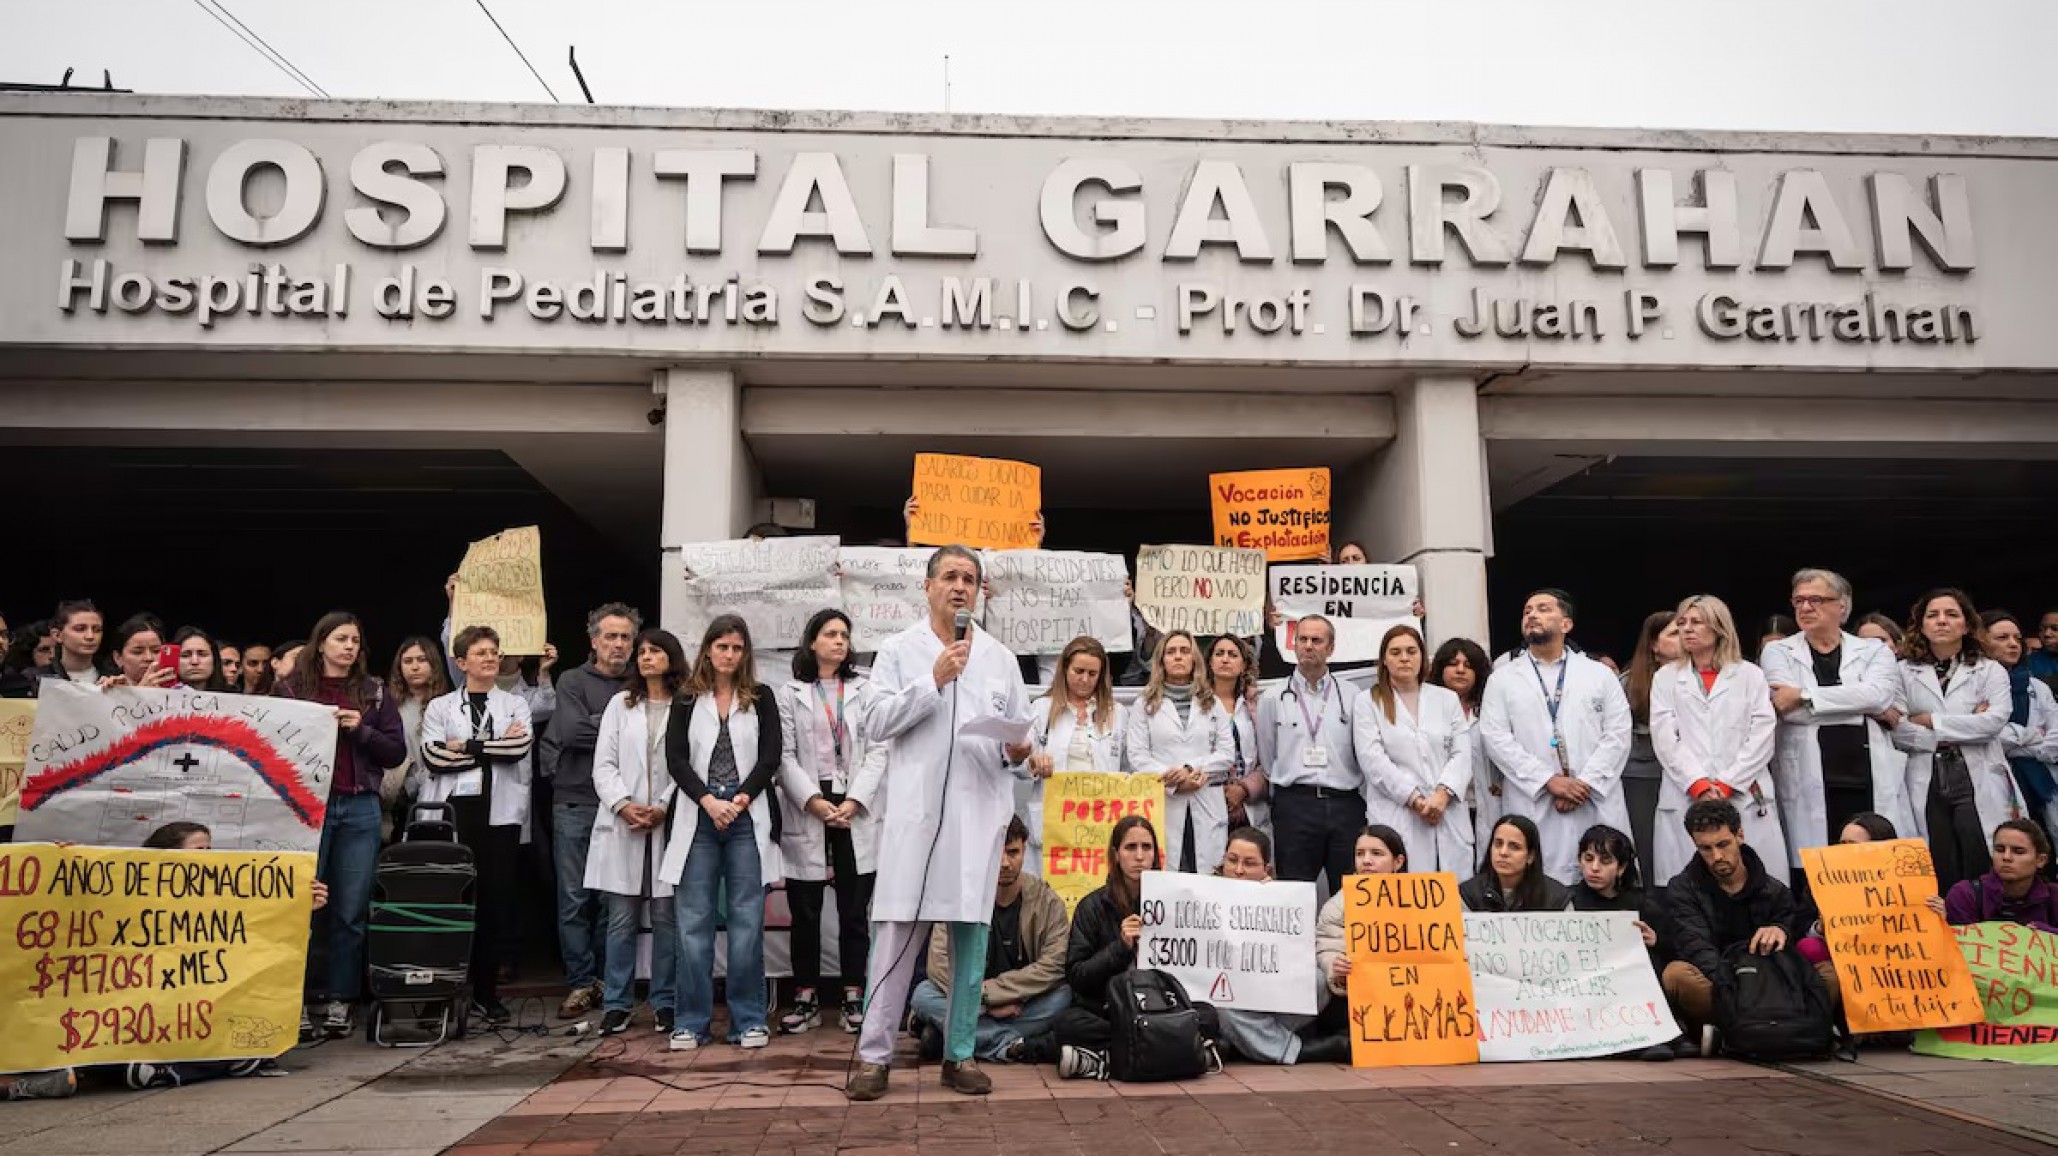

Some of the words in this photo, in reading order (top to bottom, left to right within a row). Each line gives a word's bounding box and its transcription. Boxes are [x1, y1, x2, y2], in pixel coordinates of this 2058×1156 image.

[65, 137, 977, 258] HOSPITAL
[1039, 156, 1977, 273] GARRAHAN
[58, 258, 349, 327] Hospital
[373, 265, 456, 320] de
[480, 266, 779, 324] Pediatria
[801, 272, 1117, 332] S.A.M.I.C.
[1178, 281, 1325, 336] Prof.
[1349, 282, 1432, 337] Dr.
[1453, 285, 1604, 340] Juan
[1626, 288, 1673, 341] P.
[1697, 291, 1981, 344] Garrahan
[920, 482, 952, 502] PARA
[960, 485, 1001, 506] CUIDAR
[1009, 490, 1024, 509] LA
[955, 516, 972, 539] DE
[993, 556, 1023, 581] SIN
[1034, 556, 1119, 584] RESIDENTES
[1181, 550, 1197, 572] LO
[1202, 550, 1227, 573] QUE
[1154, 576, 1189, 599] PERO
[1193, 577, 1213, 599] NO
[1216, 578, 1248, 600] VIVO
[1280, 571, 1405, 596] RESIDENCIA
[1010, 588, 1040, 611] NO
[1051, 587, 1083, 609] HAY
[1325, 601, 1353, 618] EN
[1001, 617, 1103, 643] HOSPITAL
[33, 724, 99, 761] SALUD
[0, 855, 41, 896] 10
[48, 855, 115, 897] AÑOS
[124, 861, 150, 897] DE
[157, 856, 294, 899] FORMACIÓN
[1356, 878, 1444, 909] SALUD
[1865, 884, 1909, 907] MAL
[1143, 900, 1165, 926] 80
[1175, 900, 1221, 929] HORAS
[1882, 913, 1928, 934] MAL
[16, 910, 60, 951] 68
[67, 910, 104, 948] HS
[1350, 921, 1458, 952] PÚBLICA
[1148, 934, 1197, 967] $3000
[1474, 952, 1507, 976] NO
[1520, 949, 1569, 976] PAGO
[1578, 948, 1614, 971] EL
[1885, 941, 1931, 960] MAL
[1389, 965, 1419, 986] EN
